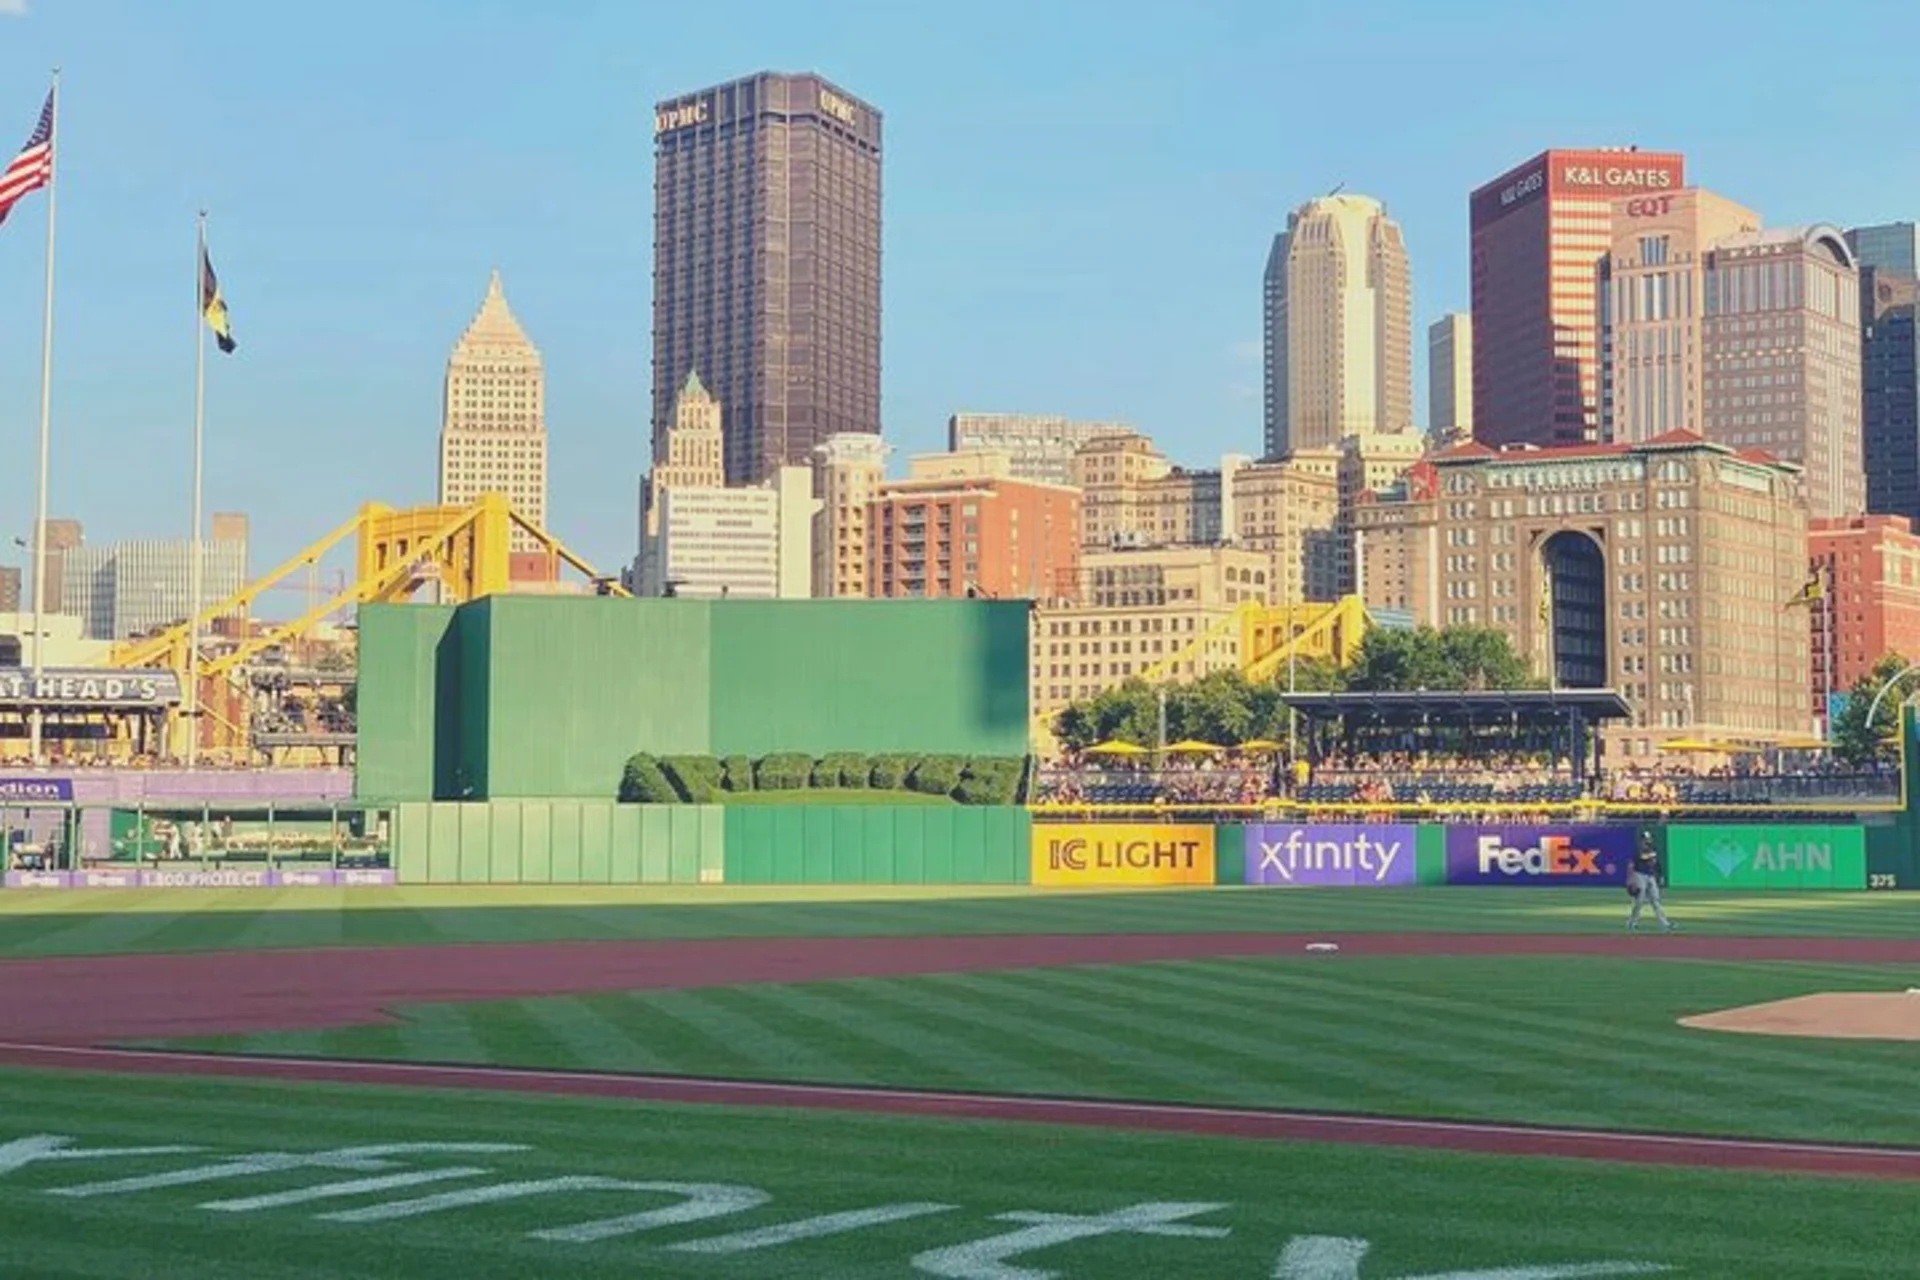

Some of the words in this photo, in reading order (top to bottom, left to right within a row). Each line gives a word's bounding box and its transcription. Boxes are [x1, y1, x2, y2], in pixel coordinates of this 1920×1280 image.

[655, 102, 708, 132] UPMC
[1564, 167, 1601, 185] K&L
[1605, 168, 1670, 187] GATES
[1626, 194, 1675, 217] EQT
[36, 678, 157, 699] HEAD'S
[1049, 839, 1087, 870] IC
[1097, 841, 1200, 869] LIGHT
[1259, 829, 1400, 881] xfinity
[1477, 835, 1601, 875] FedEx
[1752, 841, 1832, 871] AHN
